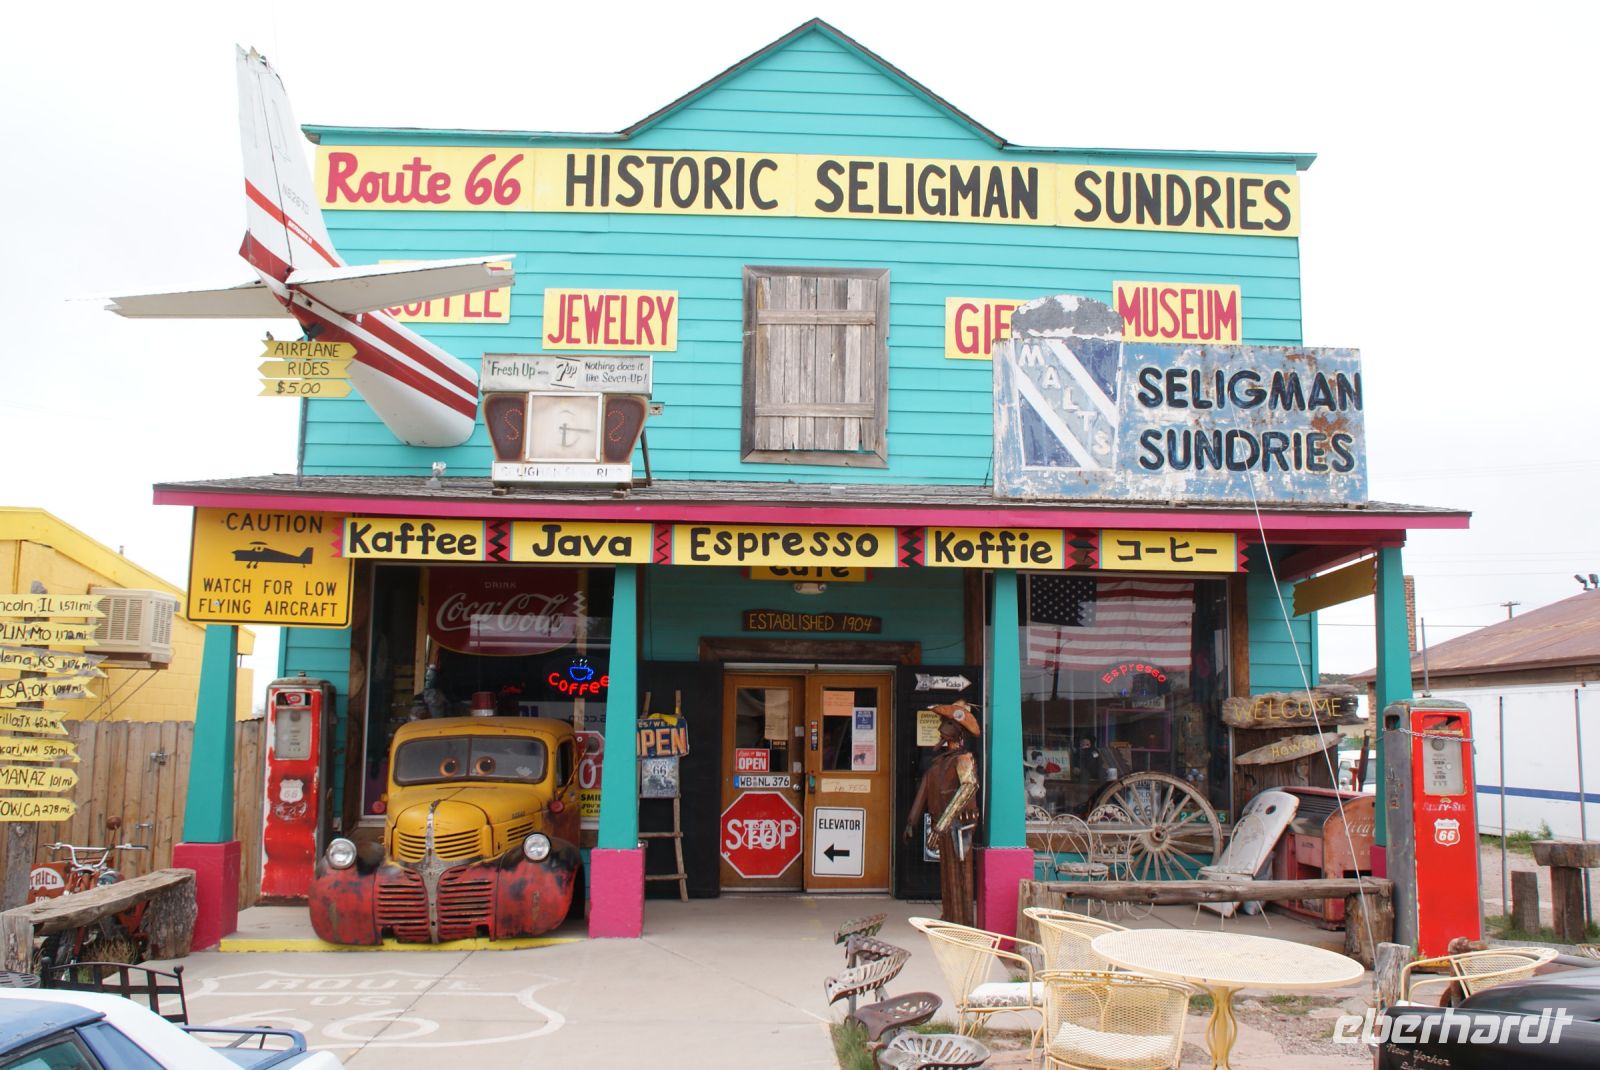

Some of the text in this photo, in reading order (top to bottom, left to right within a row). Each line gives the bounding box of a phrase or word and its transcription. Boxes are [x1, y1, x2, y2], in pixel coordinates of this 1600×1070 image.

[325, 152, 1292, 231] Route 66 HISTORIC SELIGMAN SUNDRIES
[547, 294, 675, 345] JEWELRY
[1118, 287, 1237, 341] MUSEUM
[274, 342, 341, 357] AIRPLANE
[287, 361, 330, 376] RIDES
[585, 361, 644, 373] Nothing does it
[276, 380, 321, 394] $5.00
[585, 374, 599, 383] like
[1137, 367, 1363, 411] SELIGMAN
[1019, 343, 1109, 455] MALTS
[1139, 429, 1355, 473] SUNDRIES
[226, 512, 323, 534] CAUTION
[349, 521, 1054, 565] Kaffee Java Espresso Koffie
[1116, 536, 1217, 562] コーヒー
[203, 578, 337, 596] WATCH FOR LOW
[199, 598, 338, 617] FLYING AIRCRAFT
[749, 612, 873, 631] ESTABLISHED 1904
[1103, 663, 1167, 684] Espresso
[1233, 697, 1343, 722] WELCOME
[637, 728, 687, 757] PEN
[738, 757, 767, 770] OPEN
[772, 777, 790, 787] 376
[818, 818, 861, 831] ELEVATOR
[725, 819, 797, 850] STOP
[1438, 830, 1456, 842] 66
[256, 977, 481, 991] ROUTE
[309, 993, 394, 1006] US
